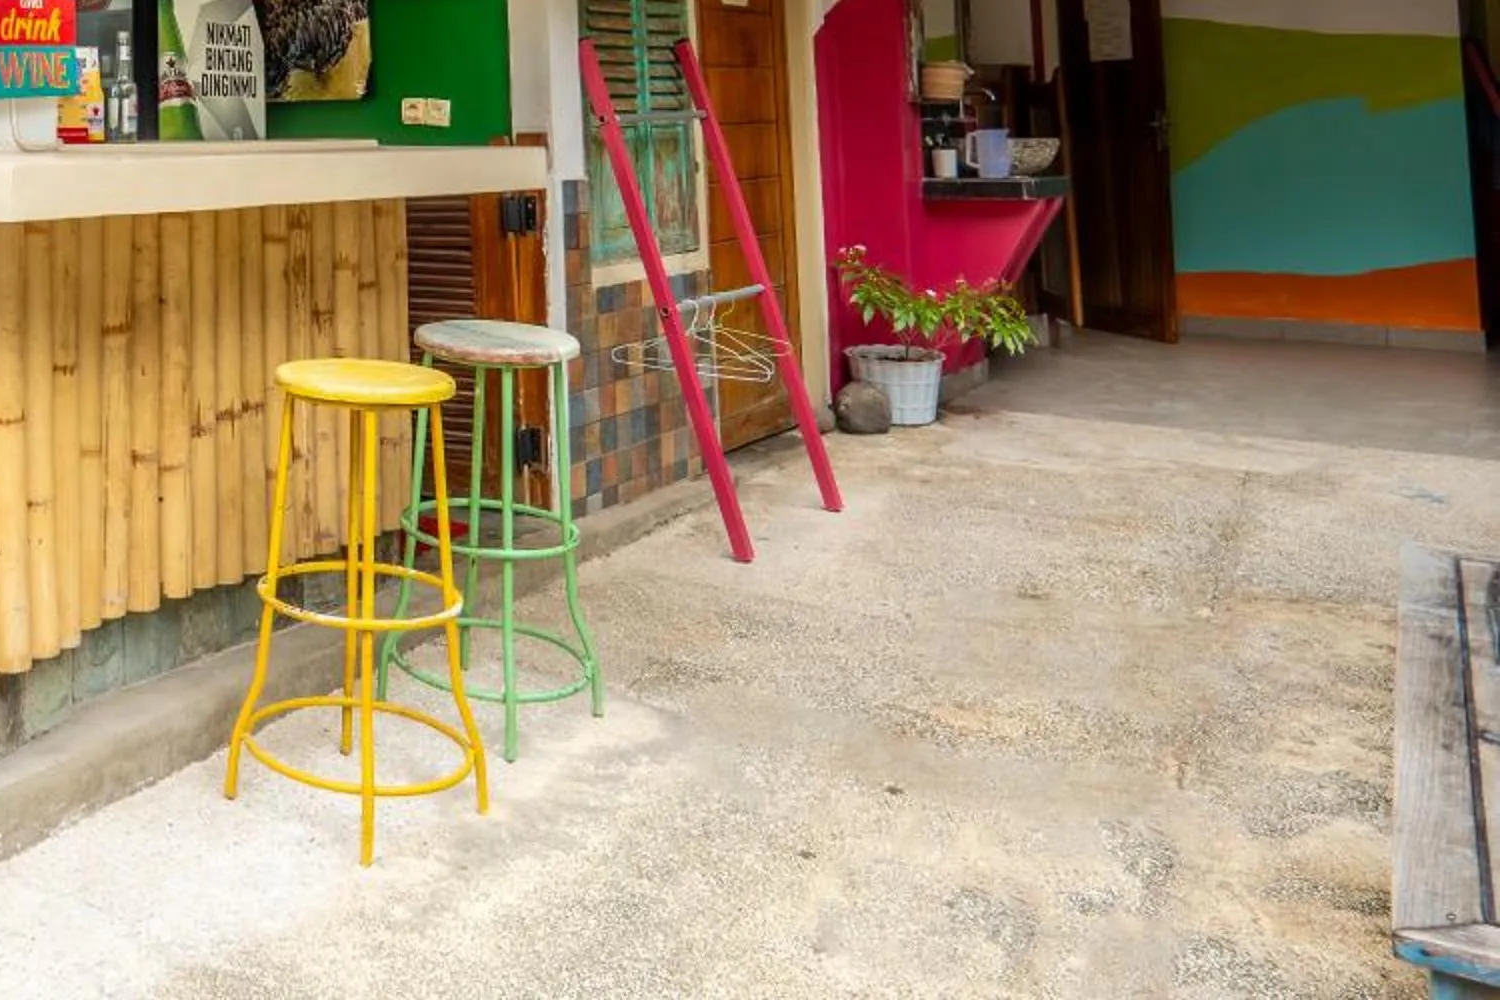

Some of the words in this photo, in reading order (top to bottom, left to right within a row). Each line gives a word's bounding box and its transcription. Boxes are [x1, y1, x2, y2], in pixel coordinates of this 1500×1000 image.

[1, 8, 61, 41] drink
[206, 22, 252, 47] NIKMATI
[205, 46, 253, 72] BINTANG
[201, 74, 257, 98] DINGINMU
